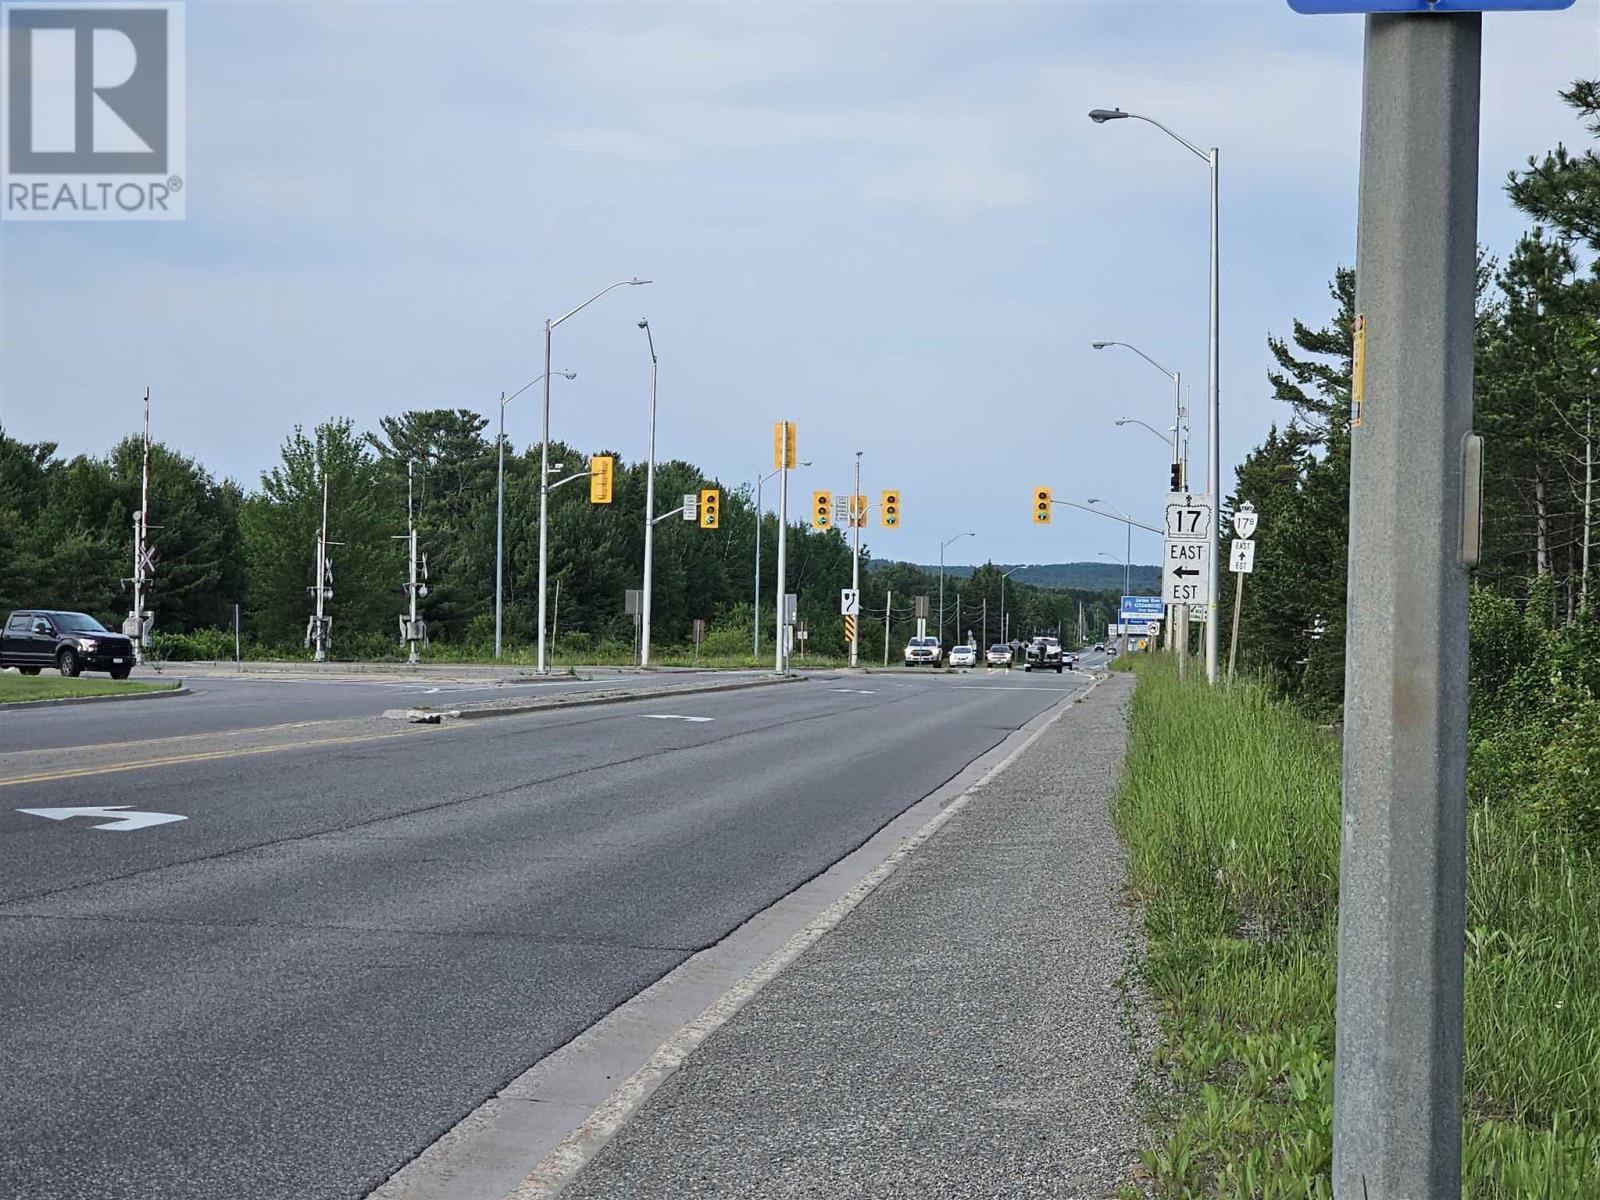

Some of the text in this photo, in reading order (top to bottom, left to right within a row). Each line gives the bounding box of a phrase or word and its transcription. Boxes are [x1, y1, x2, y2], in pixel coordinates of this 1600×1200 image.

[1176, 510, 1201, 533] 17
[1170, 545, 1203, 560] EAST
[1235, 541, 1251, 550] EAST
[1235, 562, 1247, 570] EST
[1173, 585, 1198, 600] EST
